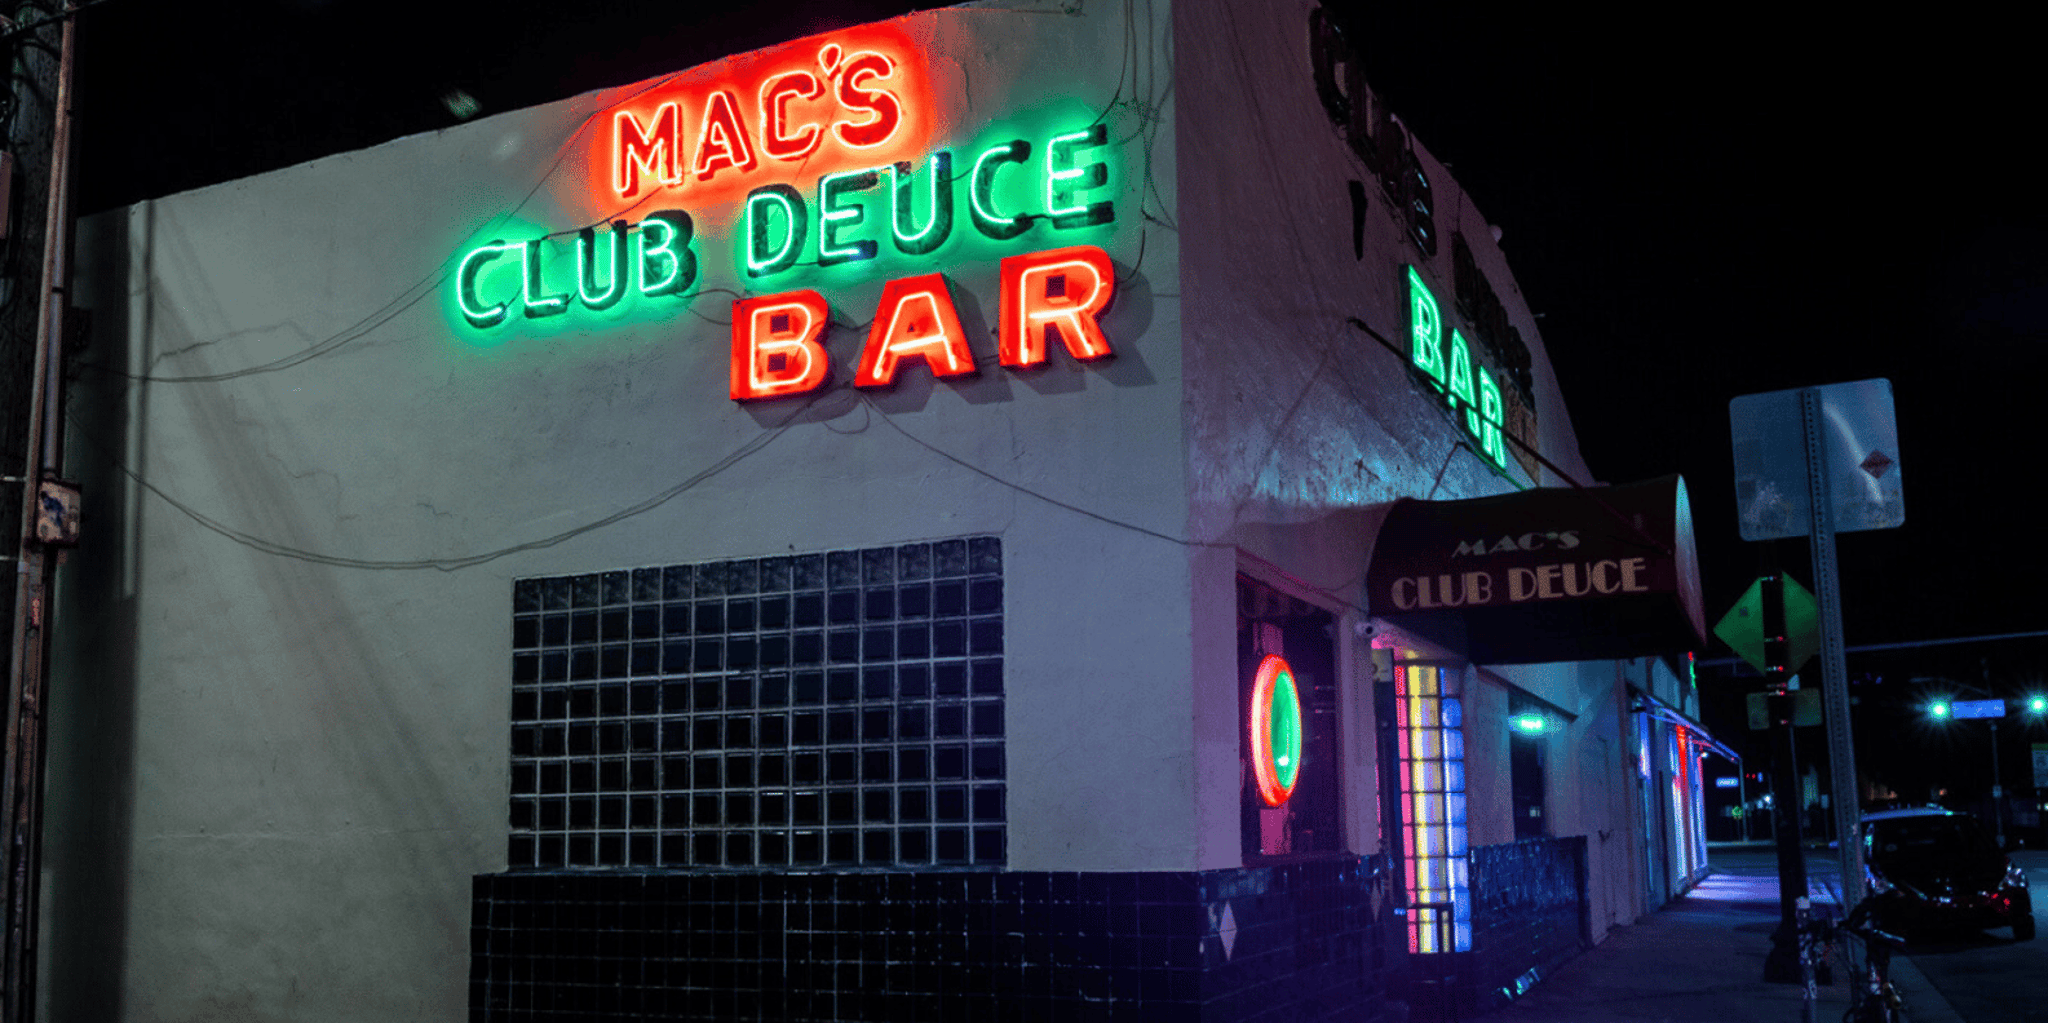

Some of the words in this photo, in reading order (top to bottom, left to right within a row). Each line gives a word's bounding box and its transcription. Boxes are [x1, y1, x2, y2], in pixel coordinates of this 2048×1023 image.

[613, 43, 903, 199] MAC'S
[456, 208, 699, 329] CLUB
[745, 123, 1116, 279] DEUCE
[731, 244, 1116, 402] BAR
[1407, 263, 1507, 469] BAR
[1391, 570, 1493, 611] CLUB
[1507, 557, 1650, 603] DEUCE
[1451, 530, 1581, 559] MAC'S
